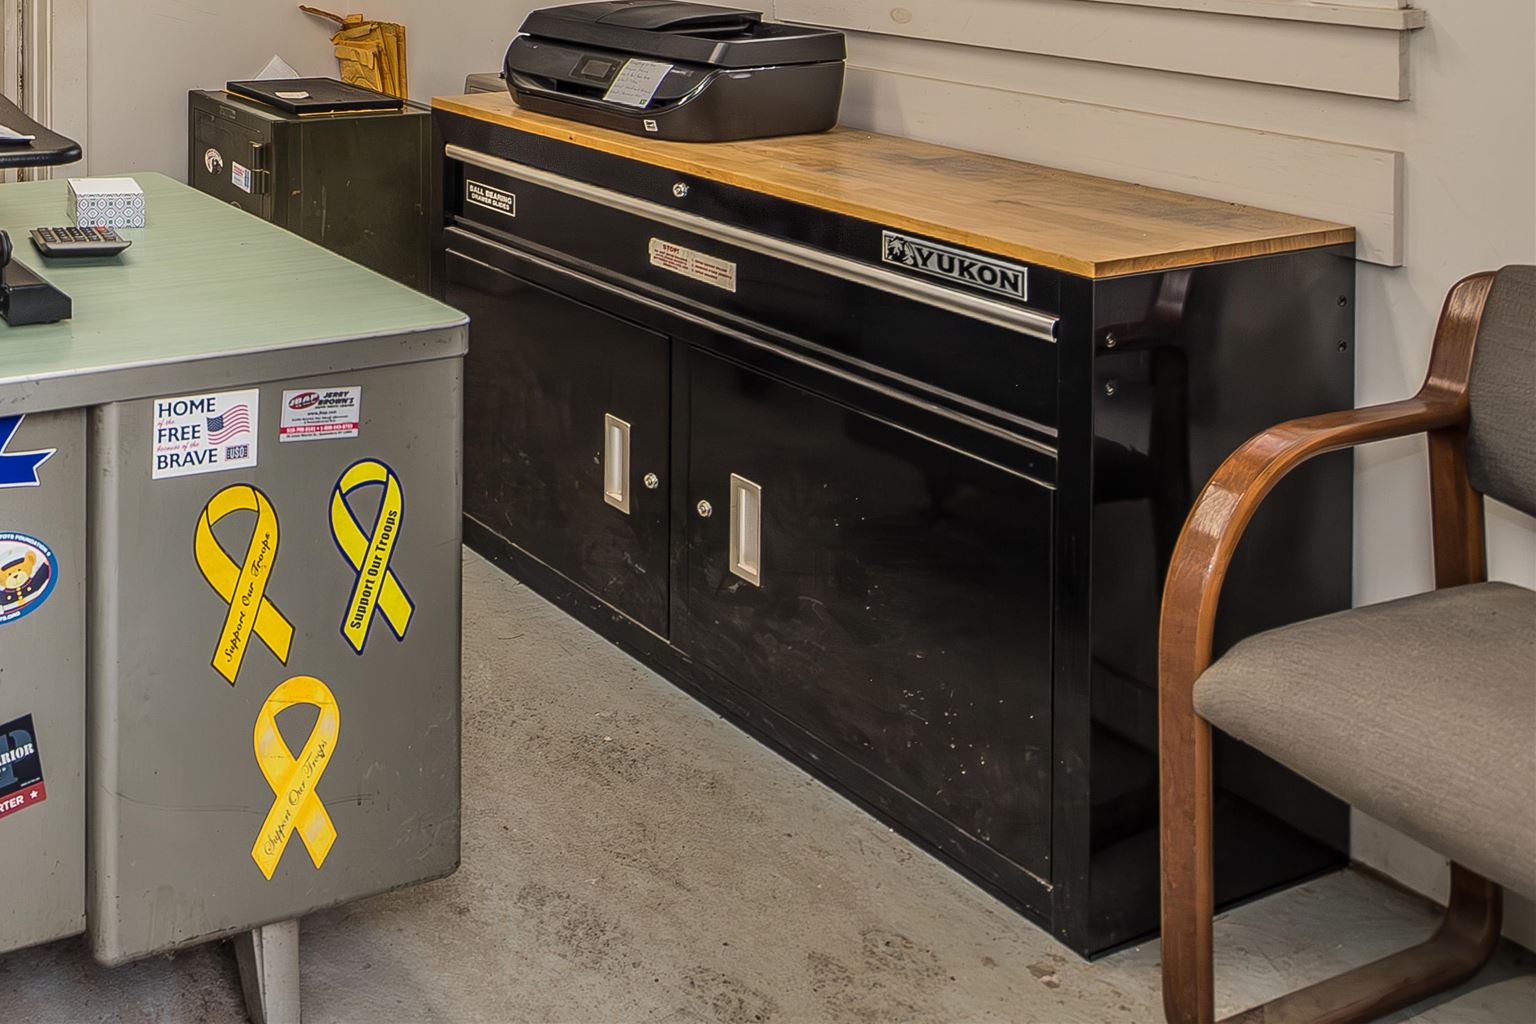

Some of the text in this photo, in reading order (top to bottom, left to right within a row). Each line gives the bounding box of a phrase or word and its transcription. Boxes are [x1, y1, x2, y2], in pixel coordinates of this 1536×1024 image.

[469, 184, 512, 205] BALL BEARING
[915, 247, 1021, 293] YUKON
[158, 397, 216, 419] HOME
[158, 424, 202, 444] FREE
[157, 448, 218, 470] BRAVE
[229, 446, 246, 459] USO
[350, 509, 399, 629] Support Our Troops
[224, 532, 270, 663] Support Our Troops
[264, 739, 328, 856] Support Our Troops
